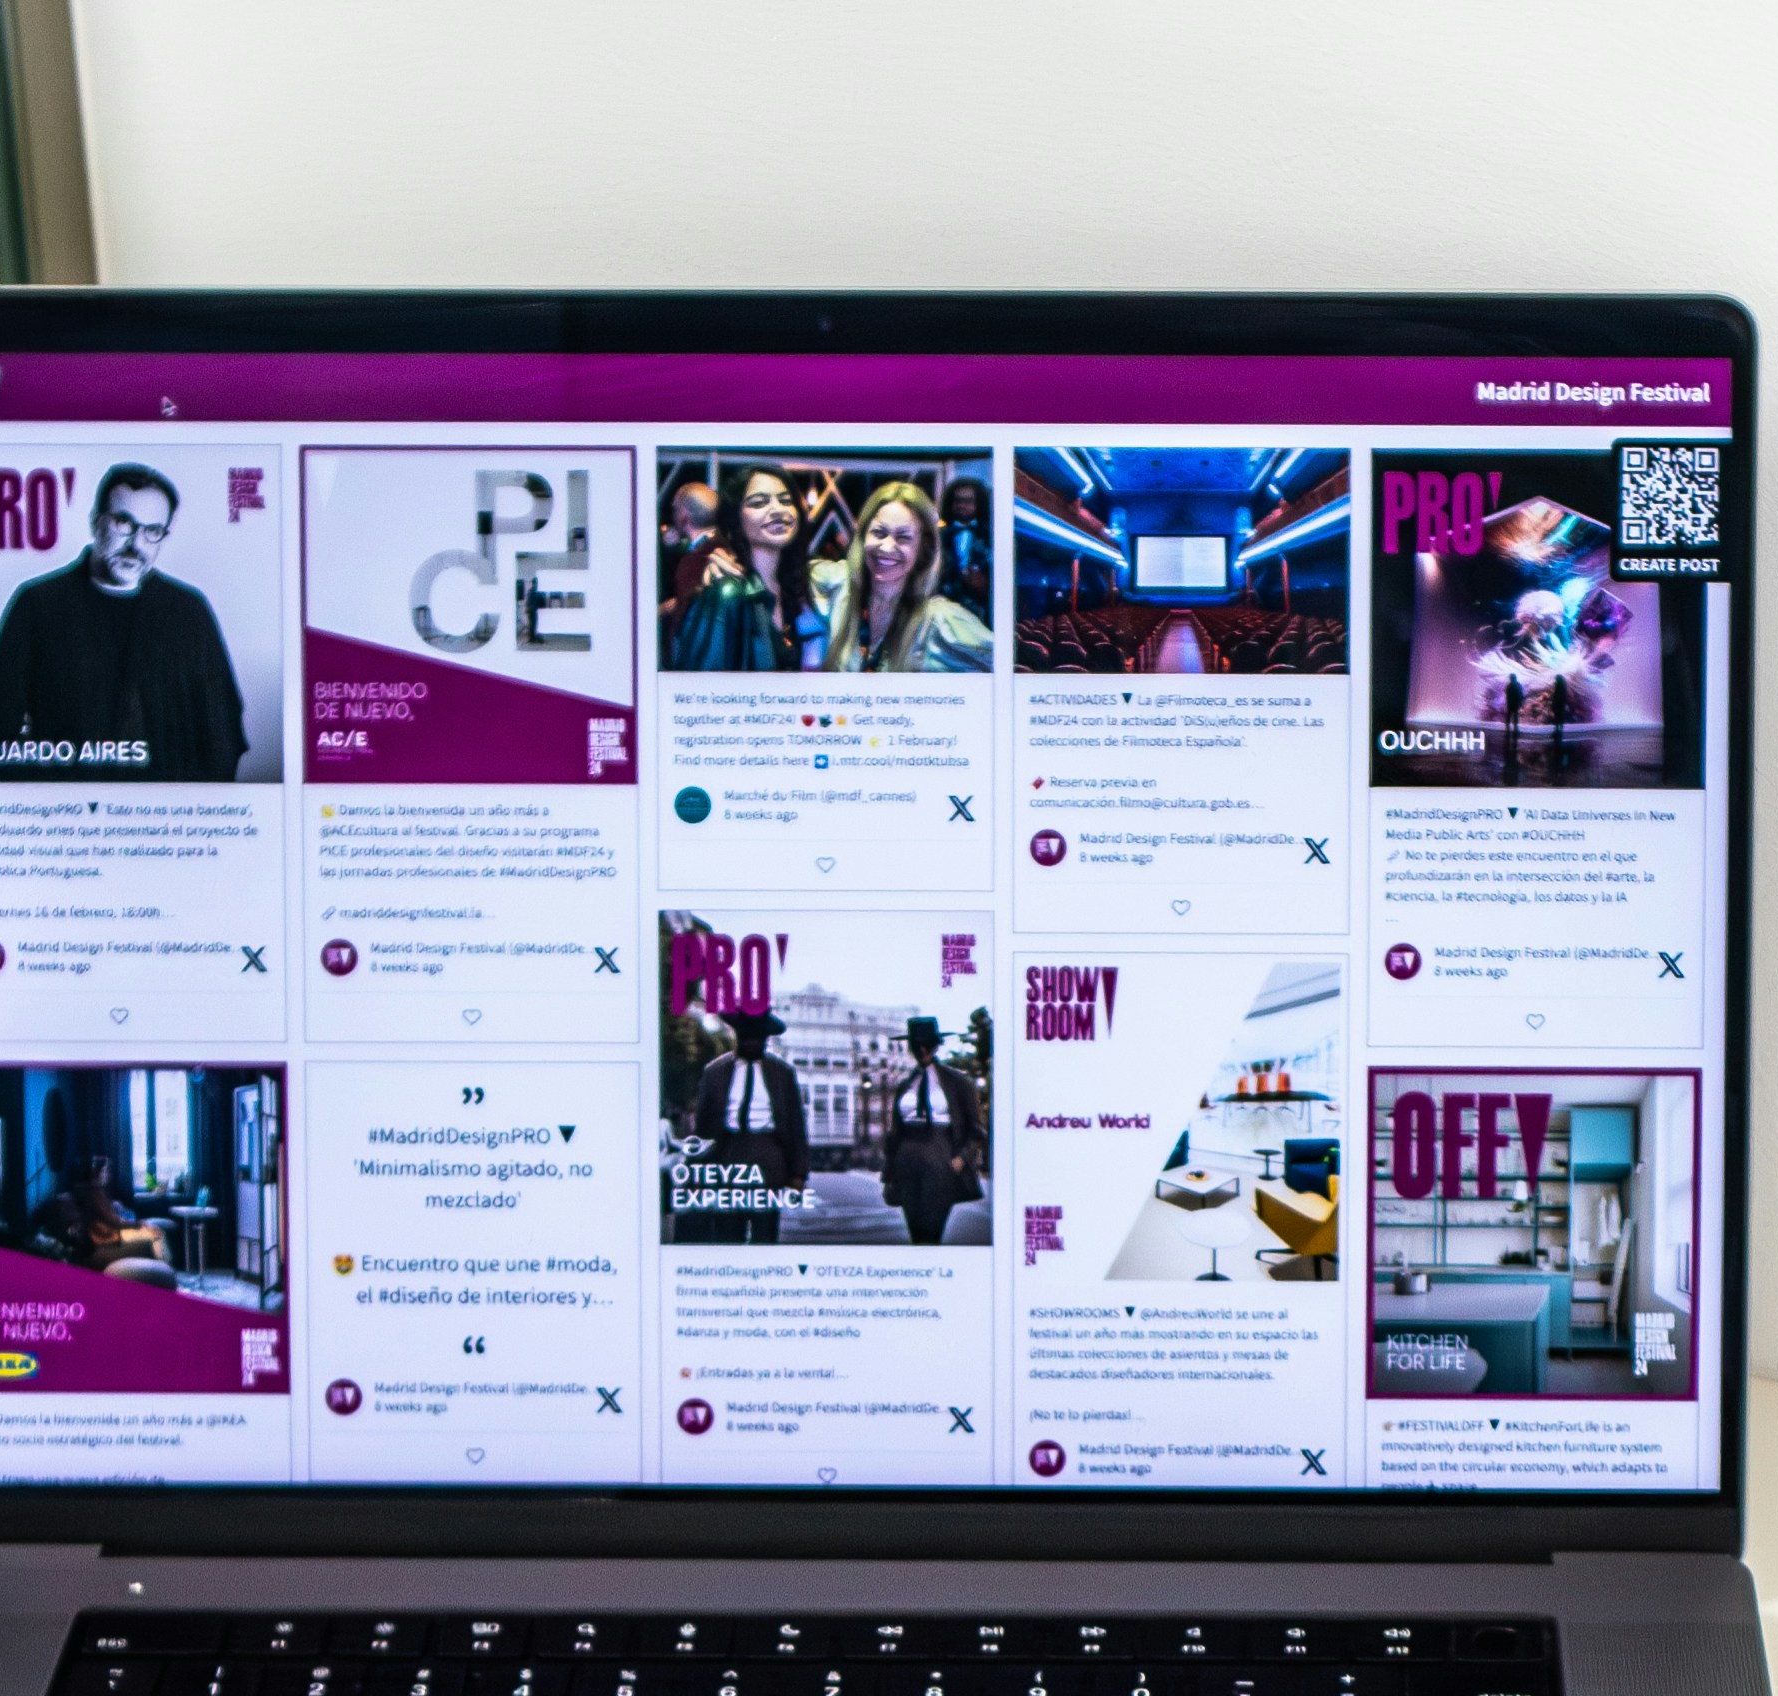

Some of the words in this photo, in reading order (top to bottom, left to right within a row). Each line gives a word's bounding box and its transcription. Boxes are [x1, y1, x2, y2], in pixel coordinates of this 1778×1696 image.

[1477, 381, 1551, 402] Madrid
[1555, 381, 1626, 407] Design
[1630, 382, 1711, 403] Festival
[1619, 558, 1676, 573] CREATE
[1679, 558, 1721, 573] POST
[313, 681, 427, 701] BIENVENIDO
[313, 702, 340, 721] DE
[317, 730, 369, 749] AC/E
[1380, 730, 1486, 752] OUCHHH
[78, 739, 148, 763] AIRES
[1026, 966, 1099, 1003] SHOW
[1026, 1003, 1096, 1041] ROOM
[1025, 1112, 1091, 1130] Andreu
[1098, 1112, 1151, 1130] World
[368, 1126, 551, 1150] #MadridDesignPRO
[1391, 1090, 1512, 1200] OFF
[487, 1159, 564, 1181] agitado,
[569, 1163, 593, 1178] no
[671, 1163, 764, 1185] OTEYZA
[671, 1188, 816, 1210] EXPERIENCE
[361, 1255, 459, 1273] Encuentro
[464, 1259, 500, 1278] que
[506, 1259, 541, 1273] une
[546, 1255, 617, 1275] #moda,
[356, 1287, 373, 1305] el
[379, 1286, 453, 1305] #diseño
[458, 1287, 481, 1305] de
[487, 1287, 577, 1305] interiores
[1386, 1333, 1469, 1352] KITCHEN
[1387, 1353, 1425, 1371] FOR
[1429, 1353, 1466, 1371] LIFE
